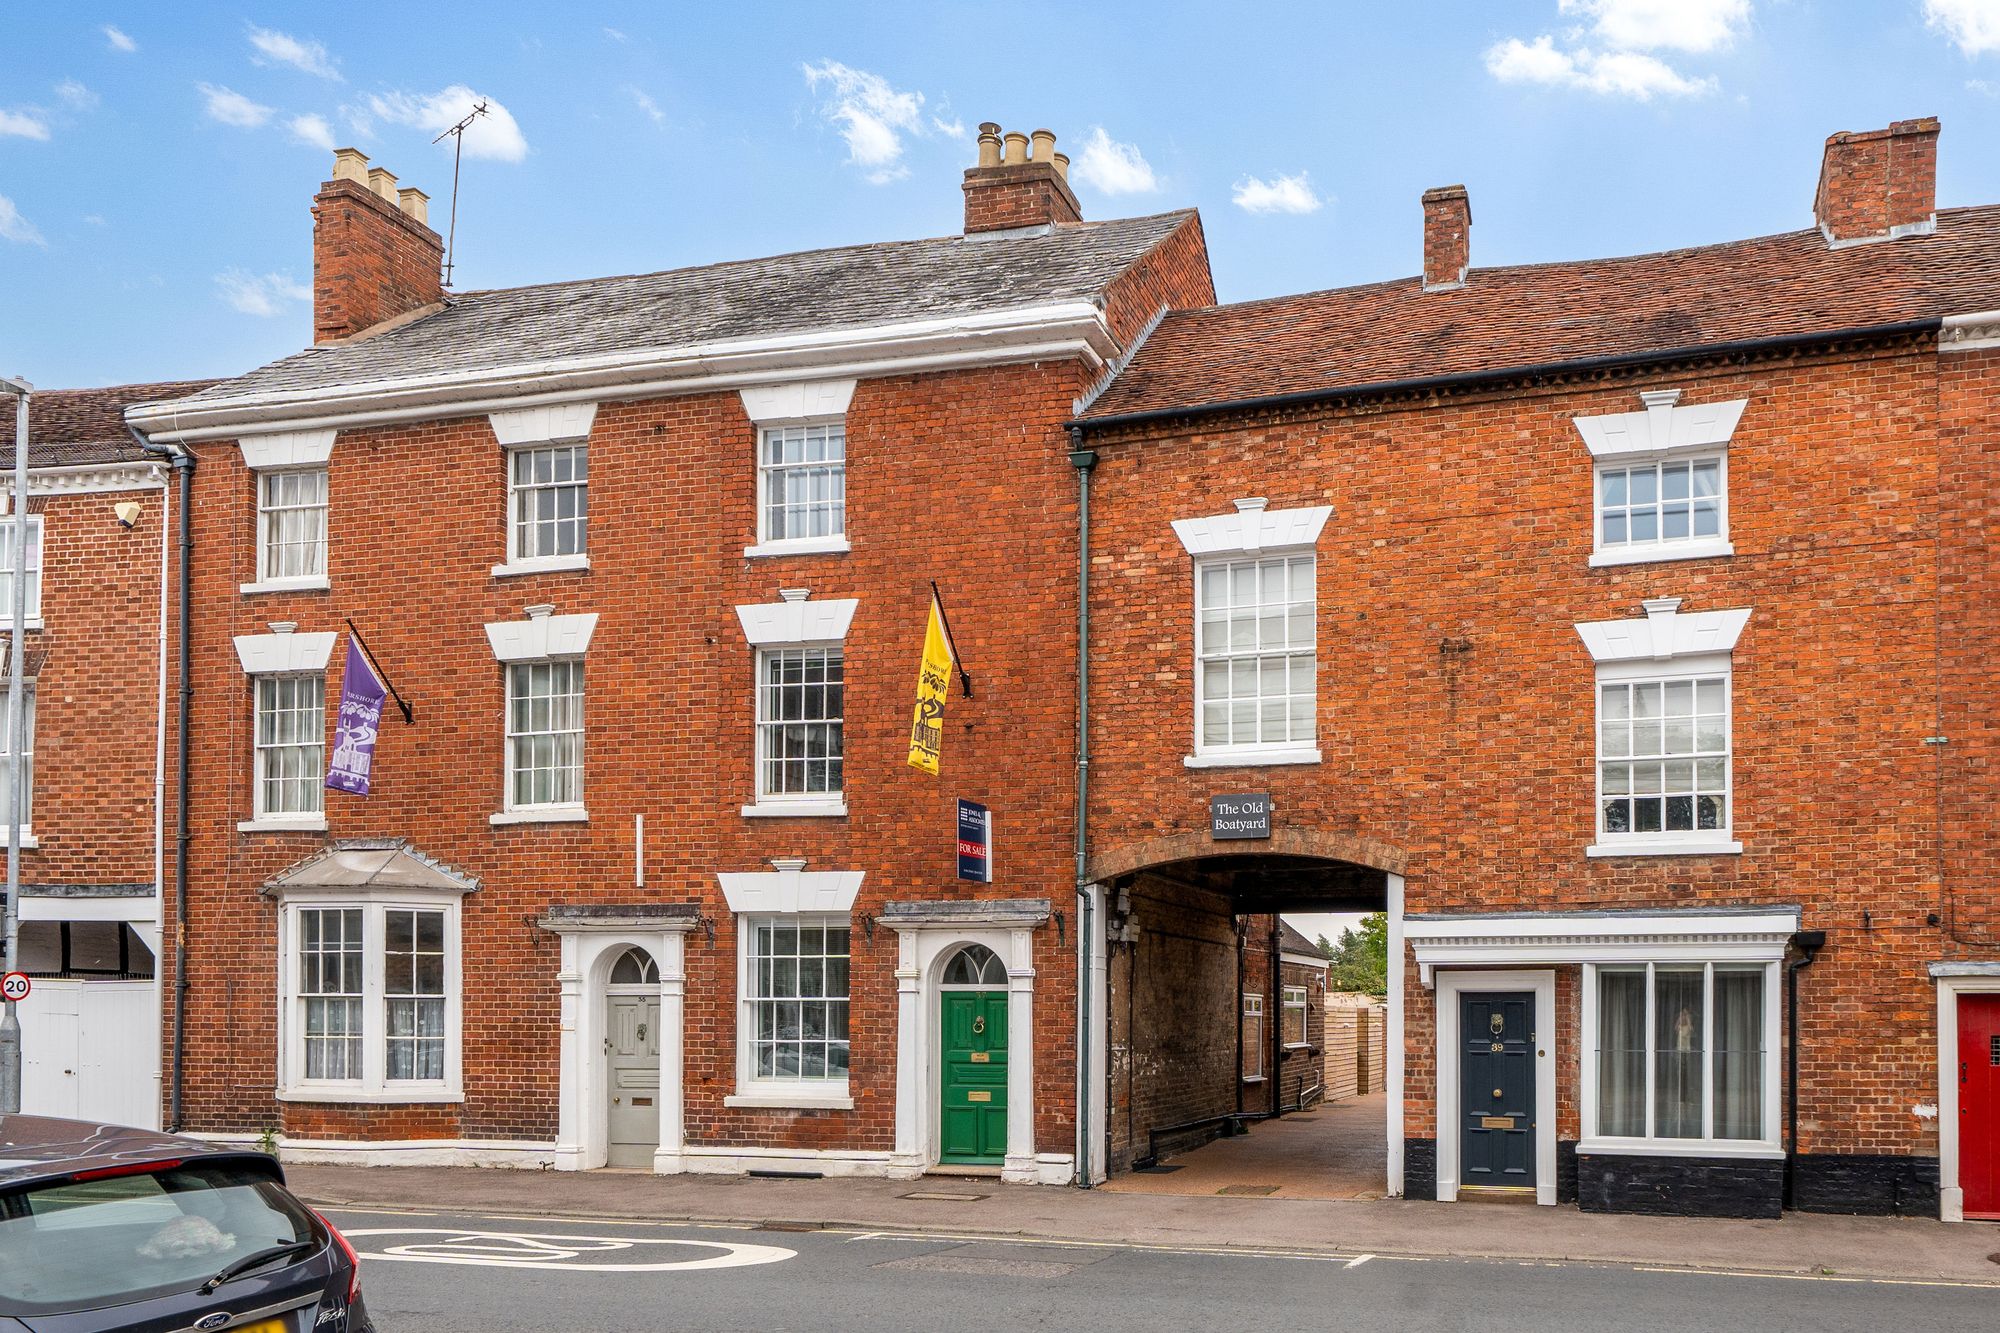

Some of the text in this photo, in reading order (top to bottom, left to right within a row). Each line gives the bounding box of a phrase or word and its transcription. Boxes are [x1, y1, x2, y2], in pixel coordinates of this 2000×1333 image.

[1217, 801, 1264, 815] The Old
[1215, 817, 1266, 832] Boatyard
[960, 843, 986, 856] FOR SALE
[5, 980, 26, 993] 20
[1491, 1043, 1504, 1052] 39
[203, 1316, 226, 1329] Ford
